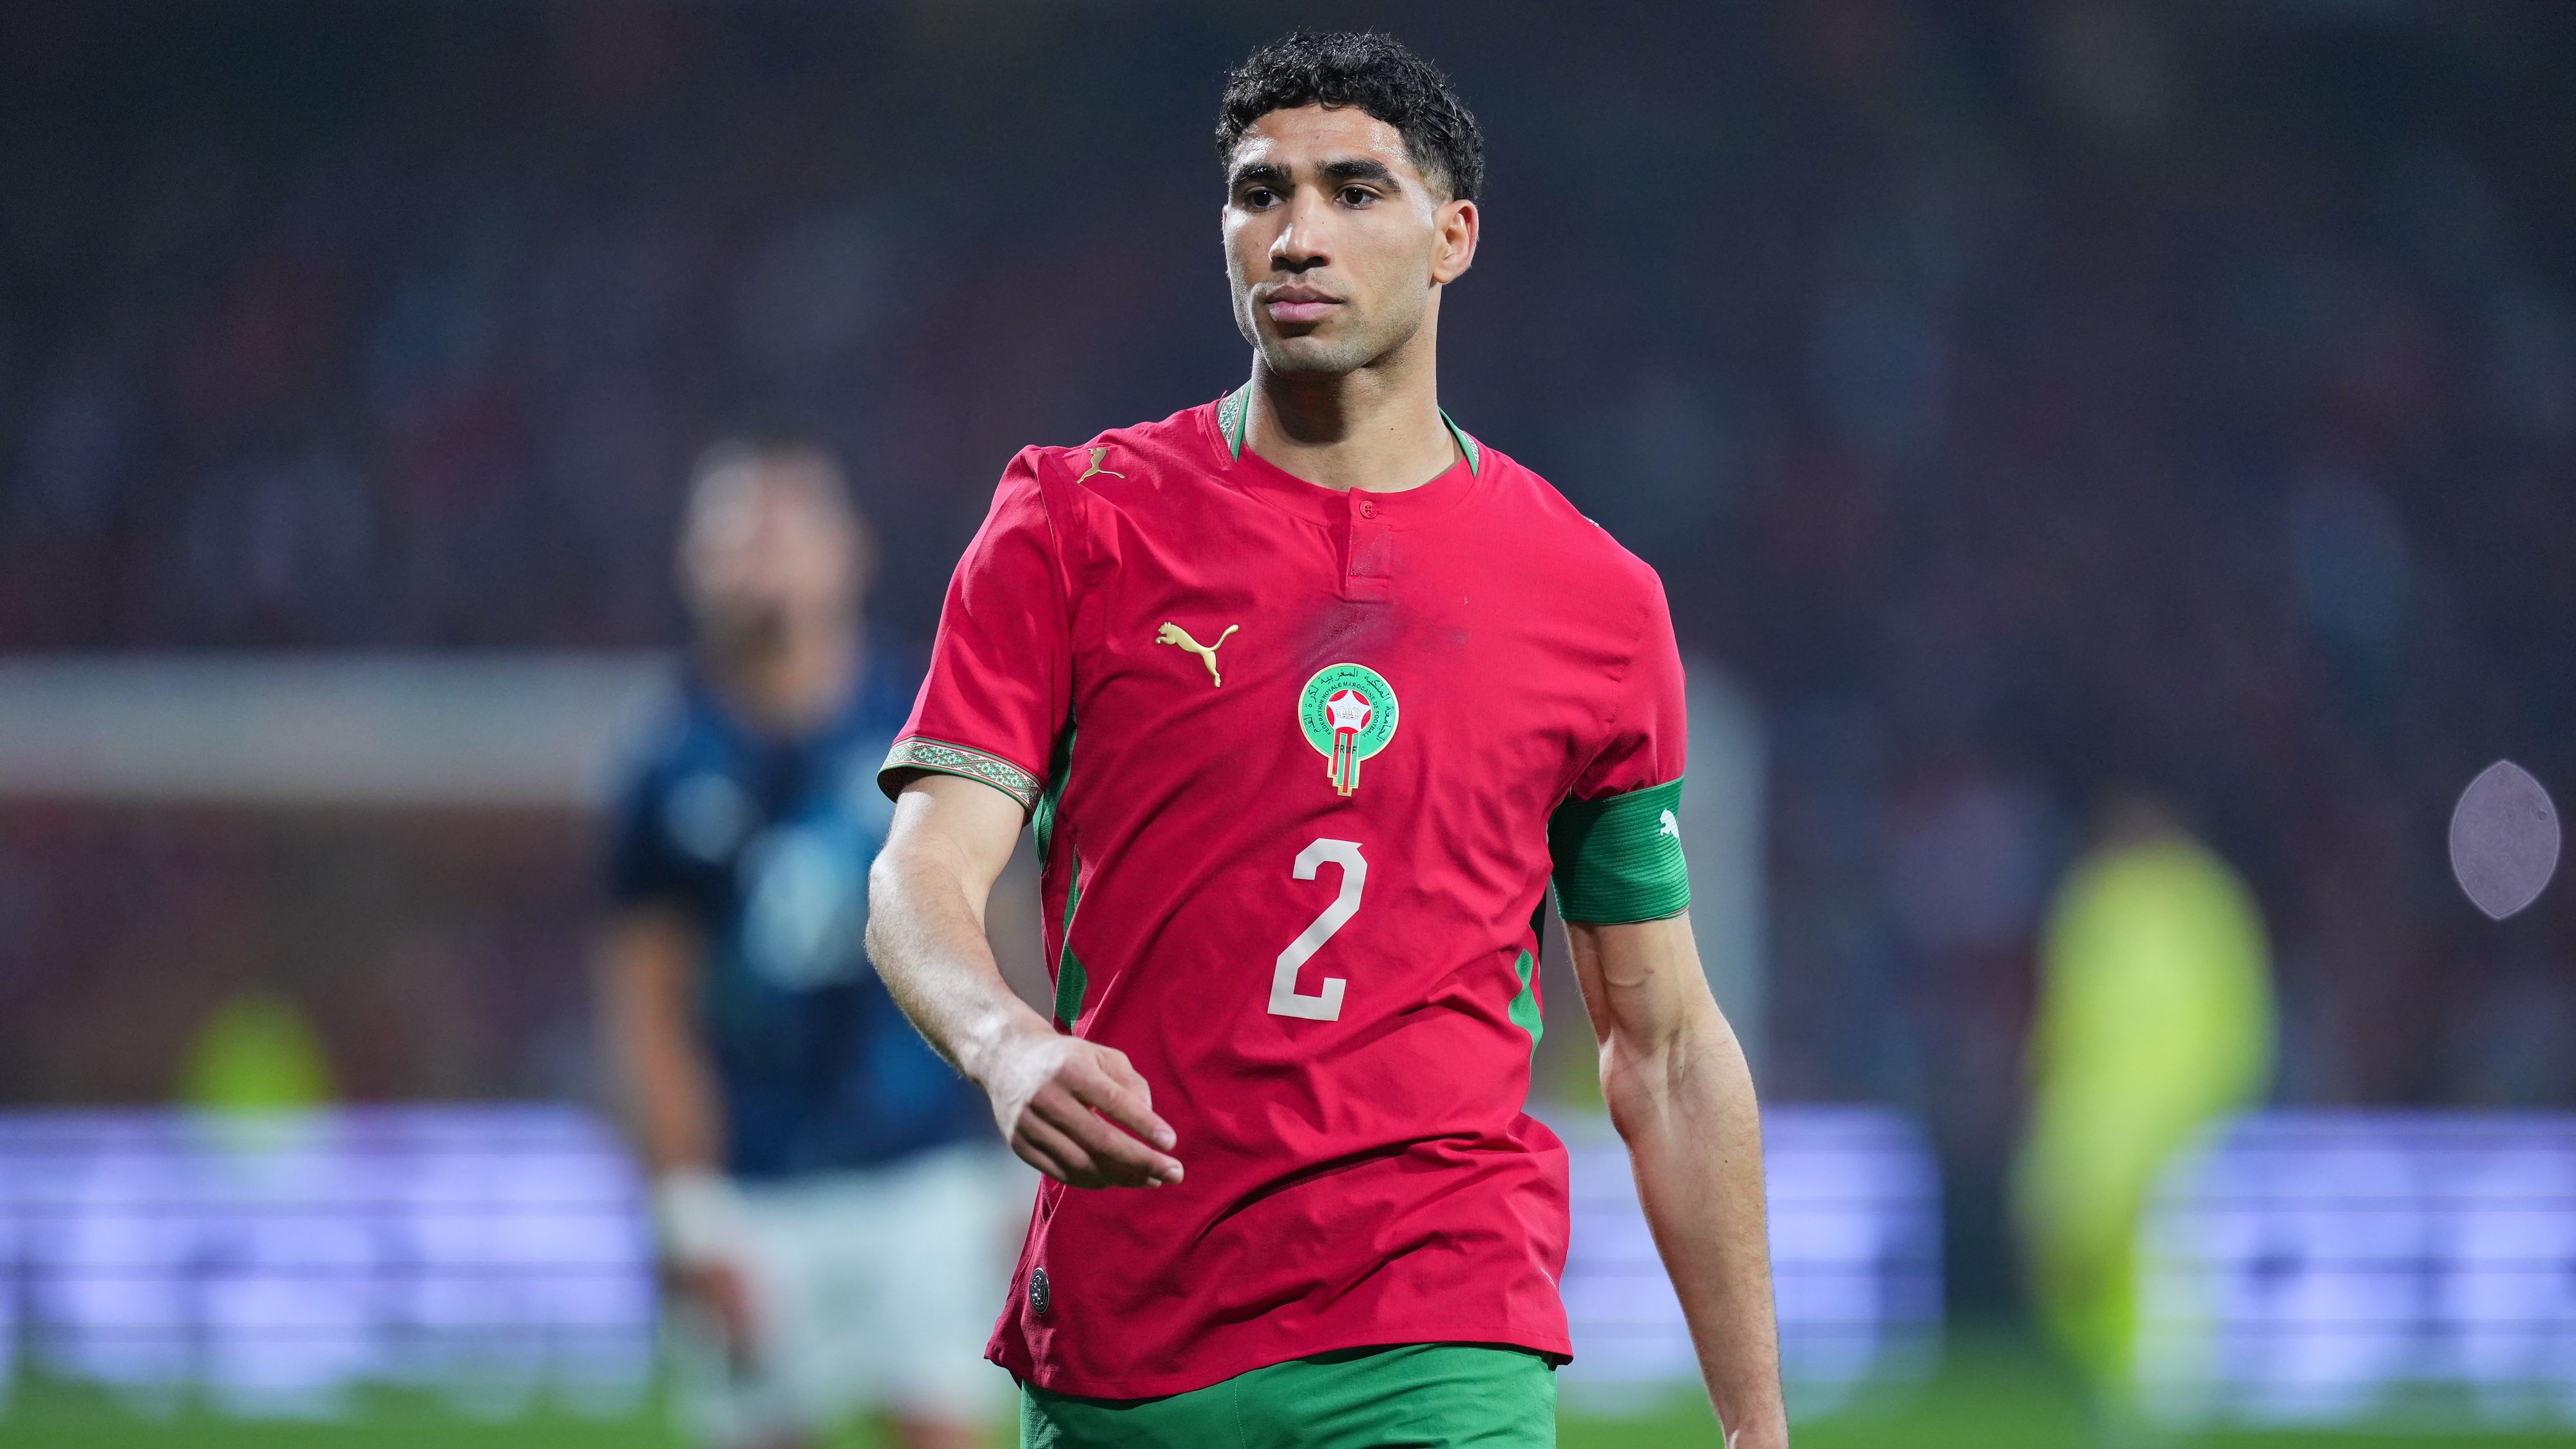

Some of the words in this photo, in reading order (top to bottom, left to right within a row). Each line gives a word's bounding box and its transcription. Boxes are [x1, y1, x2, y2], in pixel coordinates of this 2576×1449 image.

[1318, 668, 1358, 684] المغربية
[1364, 672, 1390, 701] الملكية
[1305, 685, 1319, 708] لكرة
[1321, 683, 1341, 699] ROYALE
[1343, 681, 1376, 701] MAROCAINE
[1372, 701, 1379, 709] DE
[1362, 711, 1379, 737] FOOTBALL
[1376, 706, 1394, 742] الجامعة
[1334, 744, 1357, 754] FRMF
[1267, 837, 1368, 1021] 2
